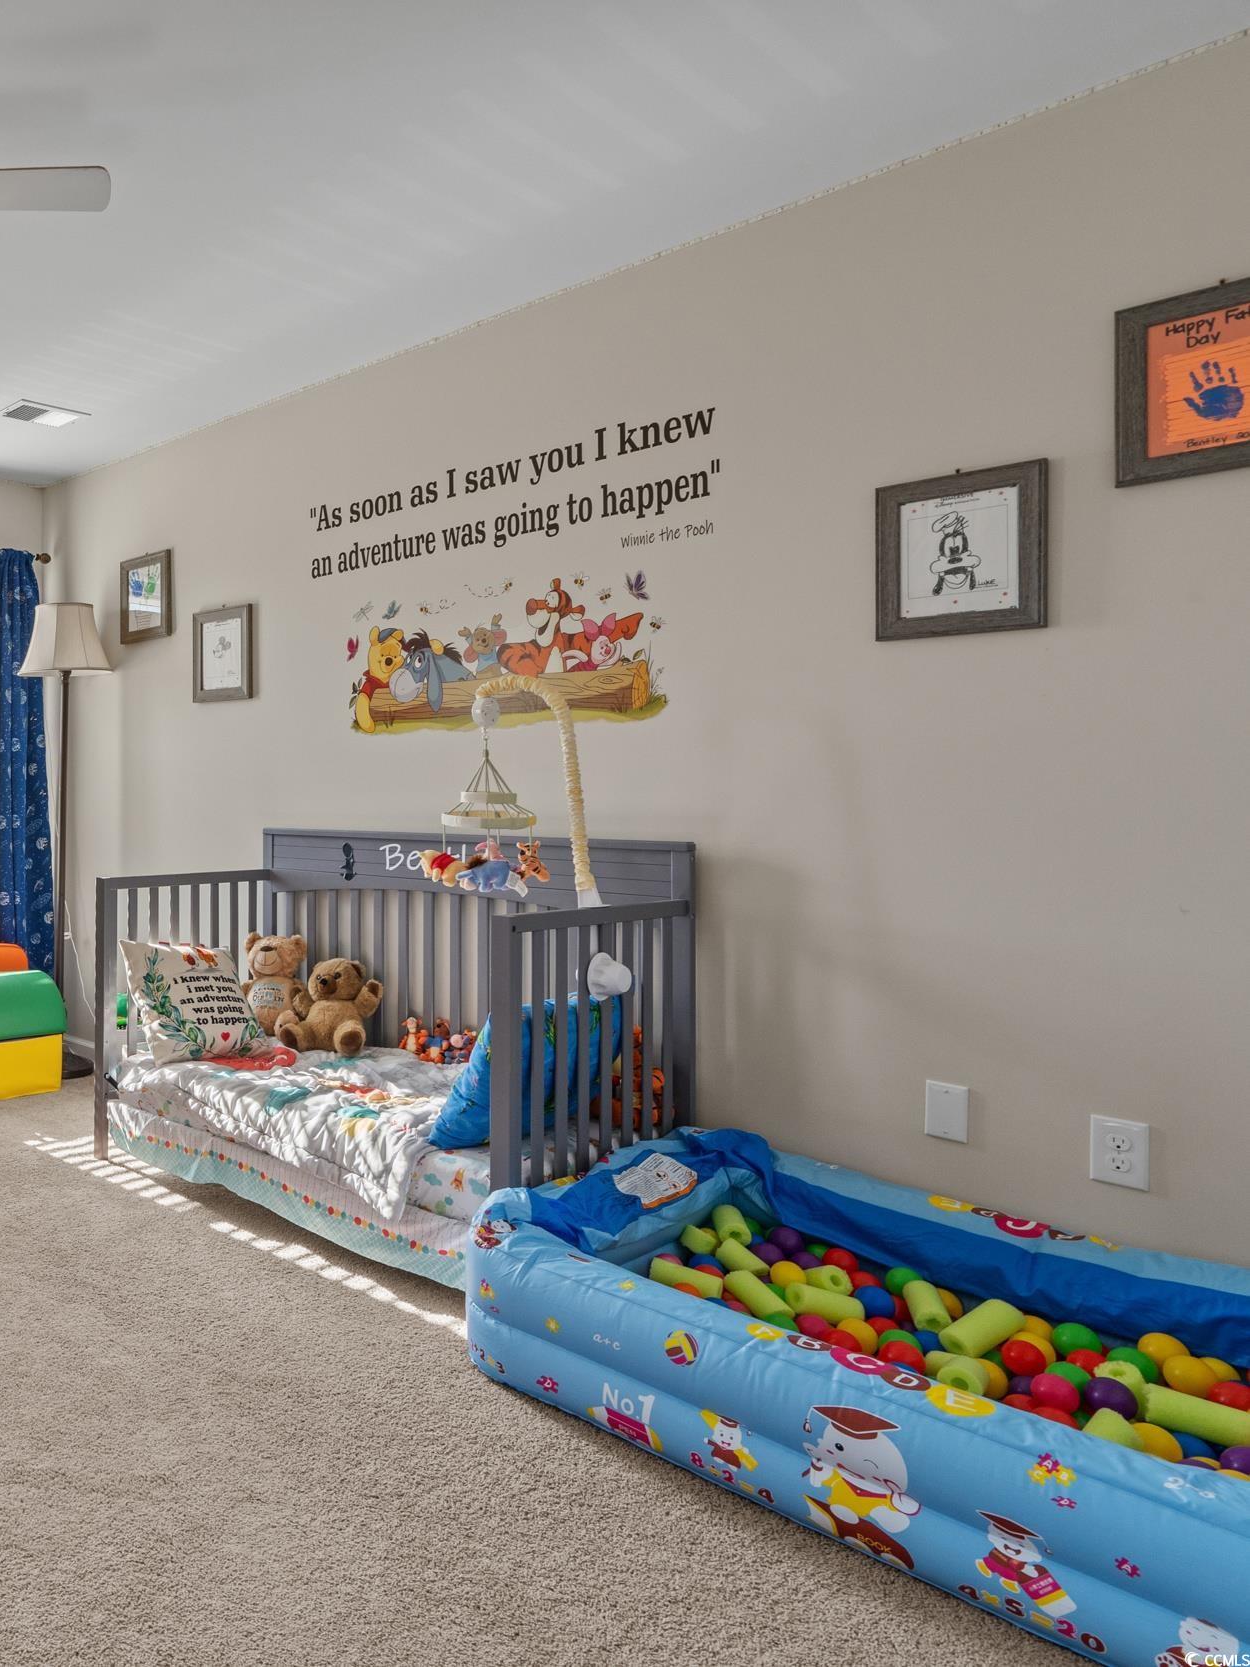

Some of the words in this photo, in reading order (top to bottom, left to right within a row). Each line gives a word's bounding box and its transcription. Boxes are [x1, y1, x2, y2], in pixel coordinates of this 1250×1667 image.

[1165, 317, 1216, 337] Happy
[1186, 332, 1221, 348] Day
[310, 504, 342, 532] "As
[350, 489, 403, 523] soon
[410, 481, 438, 508] as
[446, 468, 456, 498] I
[465, 459, 521, 494] saw
[529, 442, 584, 485] you
[595, 427, 607, 461] I
[617, 407, 716, 456] knew
[311, 554, 333, 579] an
[338, 532, 436, 573] adventure
[442, 520, 486, 550] was
[494, 502, 559, 547] going
[567, 493, 592, 525] to
[601, 459, 720, 519] happen"
[621, 530, 655, 548] Winnie
[659, 526, 680, 541] the
[684, 520, 714, 538] Pooh
[180, 975, 210, 984] knew
[187, 985, 192, 993] i
[194, 984, 214, 993] met
[217, 985, 237, 995] you,
[180, 997, 194, 1005] an
[217, 1004, 244, 1015] going
[197, 1017, 208, 1025] to
[211, 1015, 249, 1025] happen
[846, 1353, 885, 1369] C
[893, 1372, 919, 1387] D
[945, 1388, 978, 1412] E
[856, 1532, 892, 1554] BOOK
